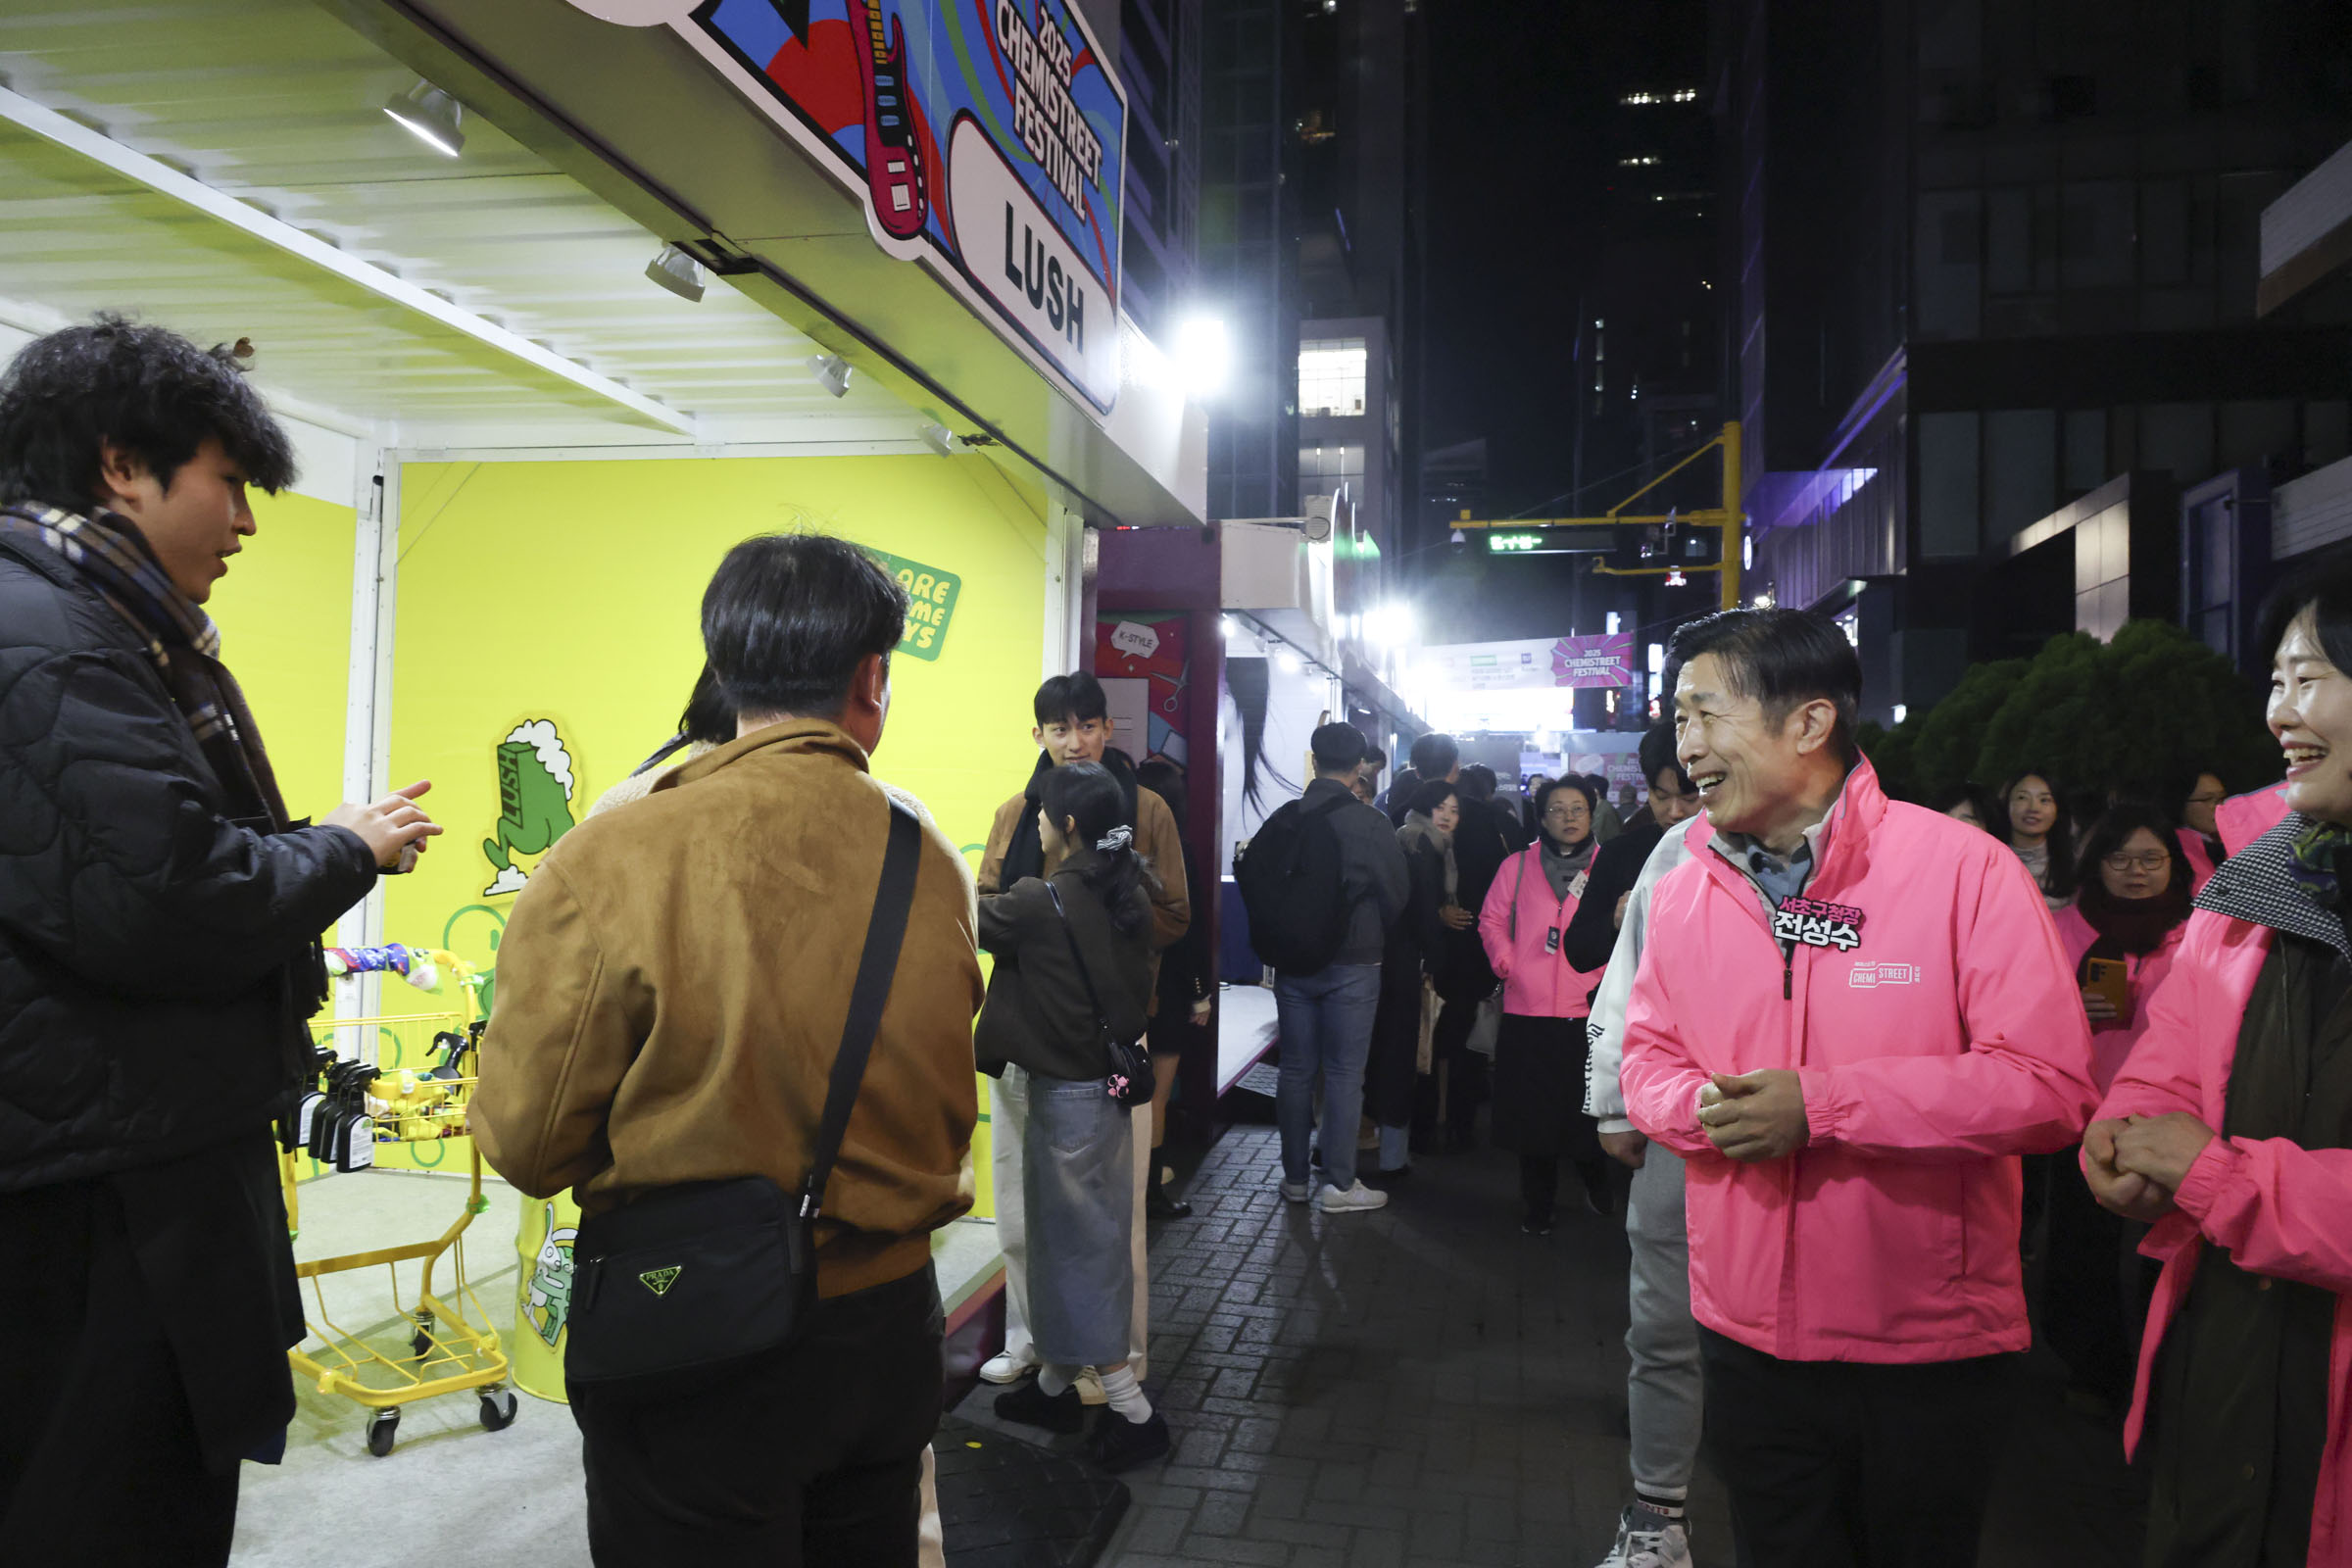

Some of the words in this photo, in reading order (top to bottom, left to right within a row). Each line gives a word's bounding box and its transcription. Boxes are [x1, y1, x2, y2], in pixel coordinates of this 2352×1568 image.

[1039, 4, 1073, 88] 2025
[996, 0, 1102, 191] CHEMISTREET
[1013, 77, 1087, 223] FESTIVAL
[1005, 200, 1084, 355] LUSH
[908, 600, 946, 626] ME
[1119, 630, 1153, 649] K-STYLE
[1584, 648, 1601, 658] 2025
[1564, 656, 1621, 668] CHEMISTREET
[1573, 666, 1611, 677] FESTIVAL
[498, 749, 523, 826] LUSH
[1780, 896, 1861, 925] 서초구청장
[1775, 910, 1859, 951] 전성수
[1853, 972, 1876, 983] CHEMI
[1879, 967, 1907, 979] STREET
